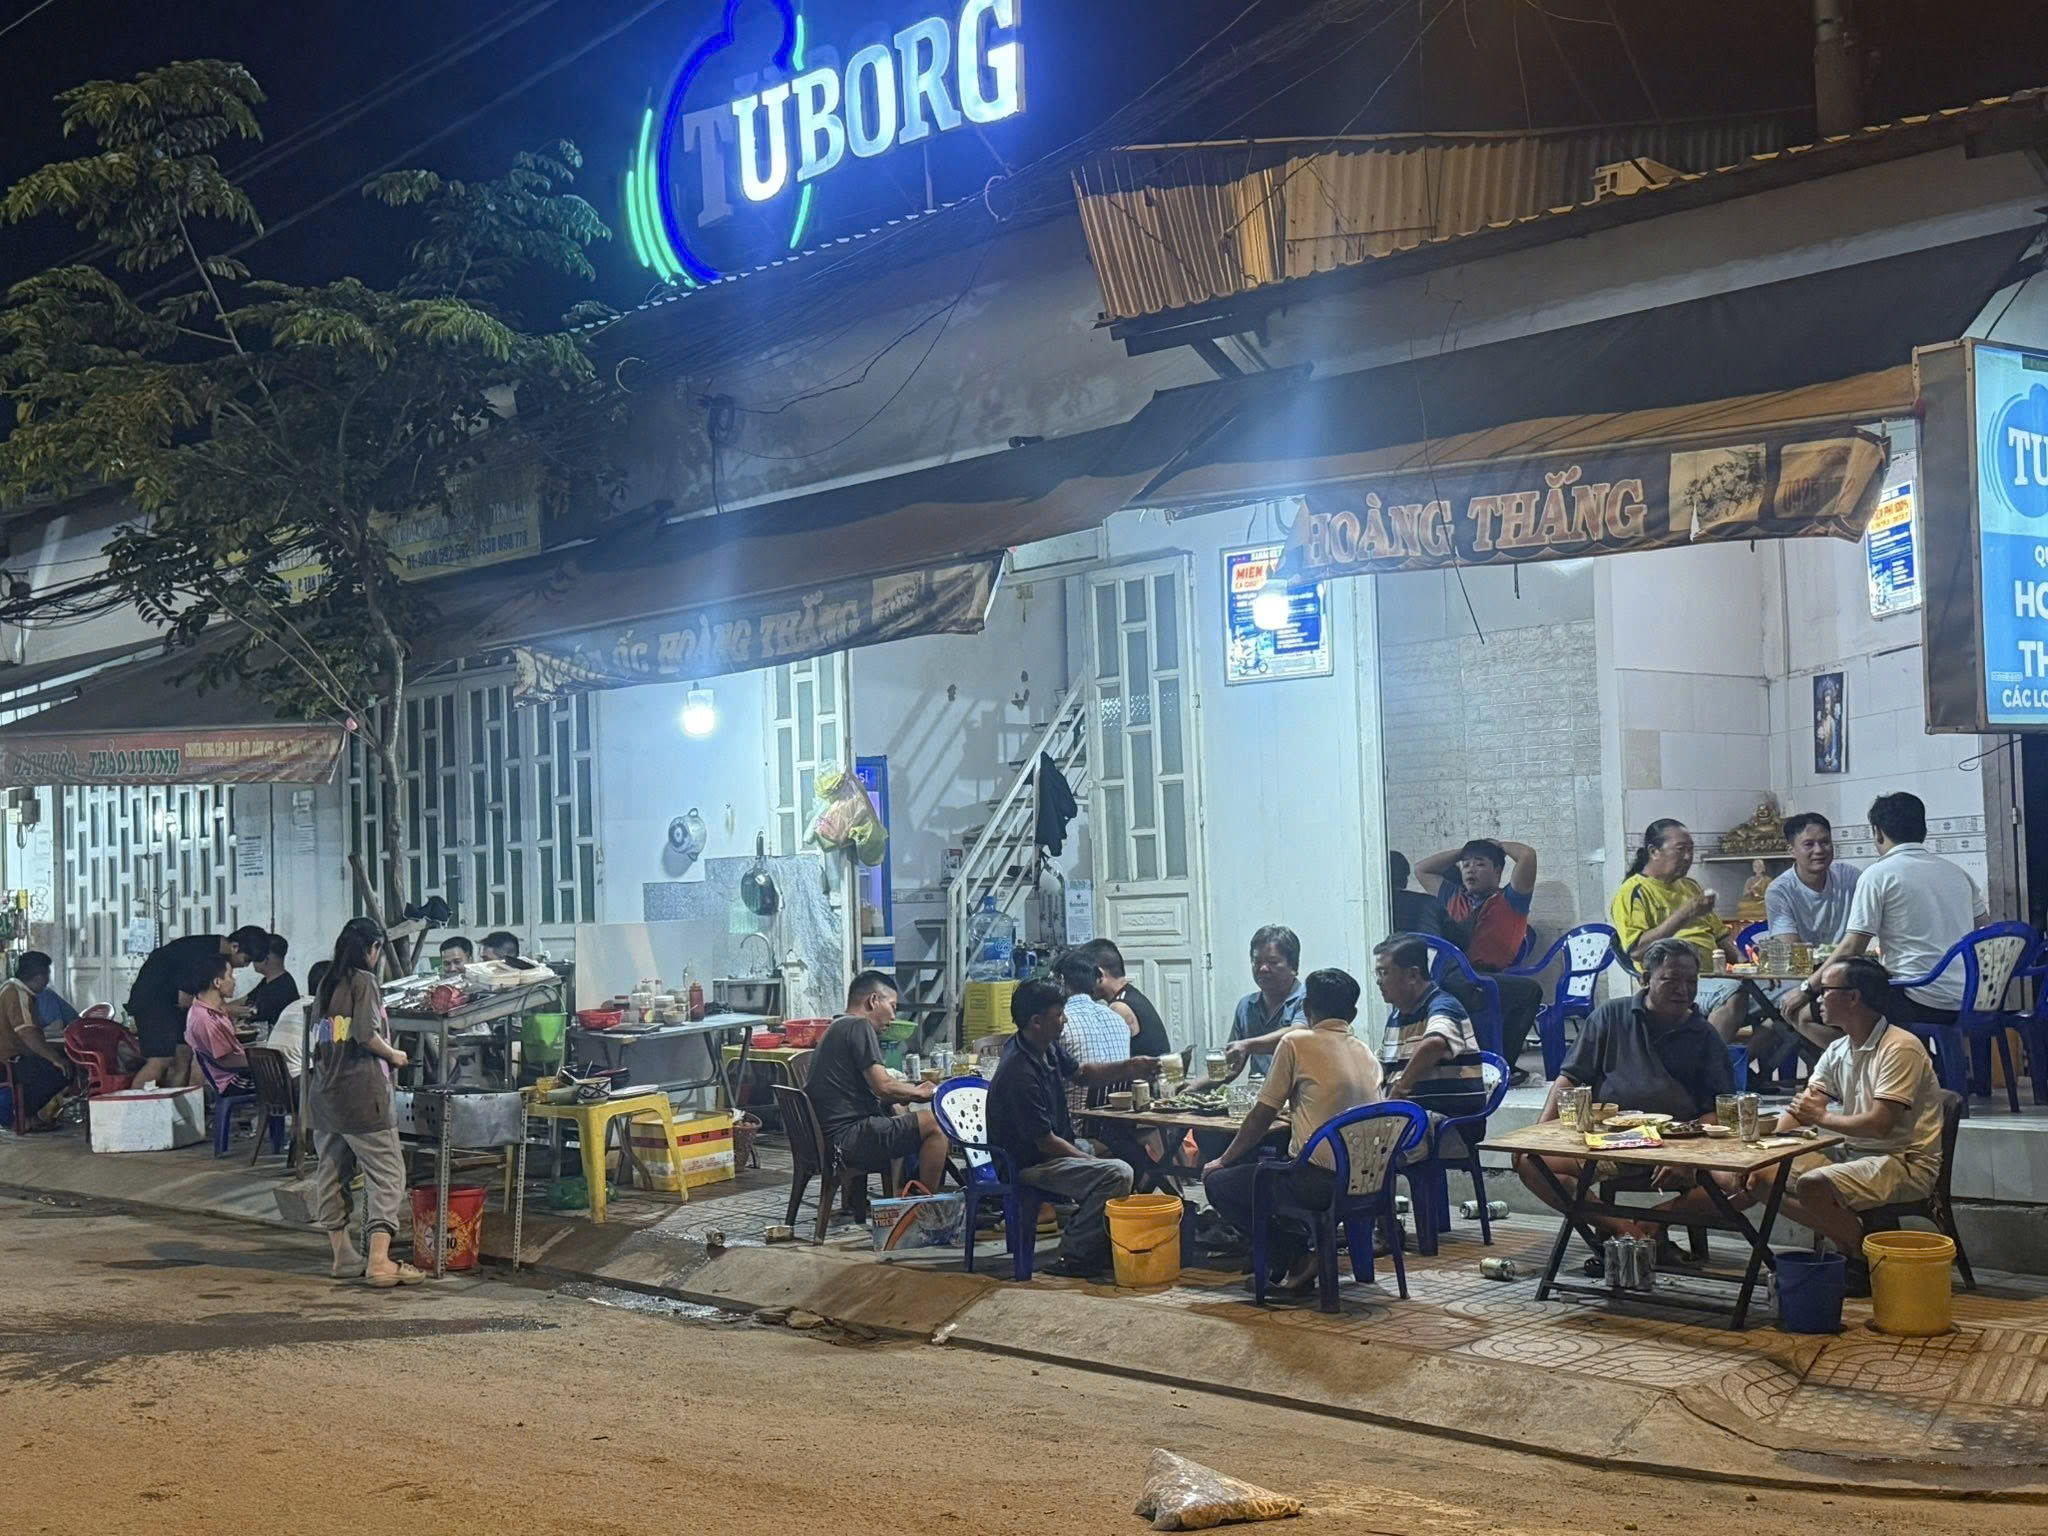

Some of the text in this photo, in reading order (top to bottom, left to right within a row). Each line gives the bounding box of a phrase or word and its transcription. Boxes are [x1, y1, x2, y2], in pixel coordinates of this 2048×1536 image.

[682, 0, 1024, 228] TUBORG
[1304, 465, 1648, 568] HOÀNG THẮNG
[2002, 685, 2031, 708] CÁC
